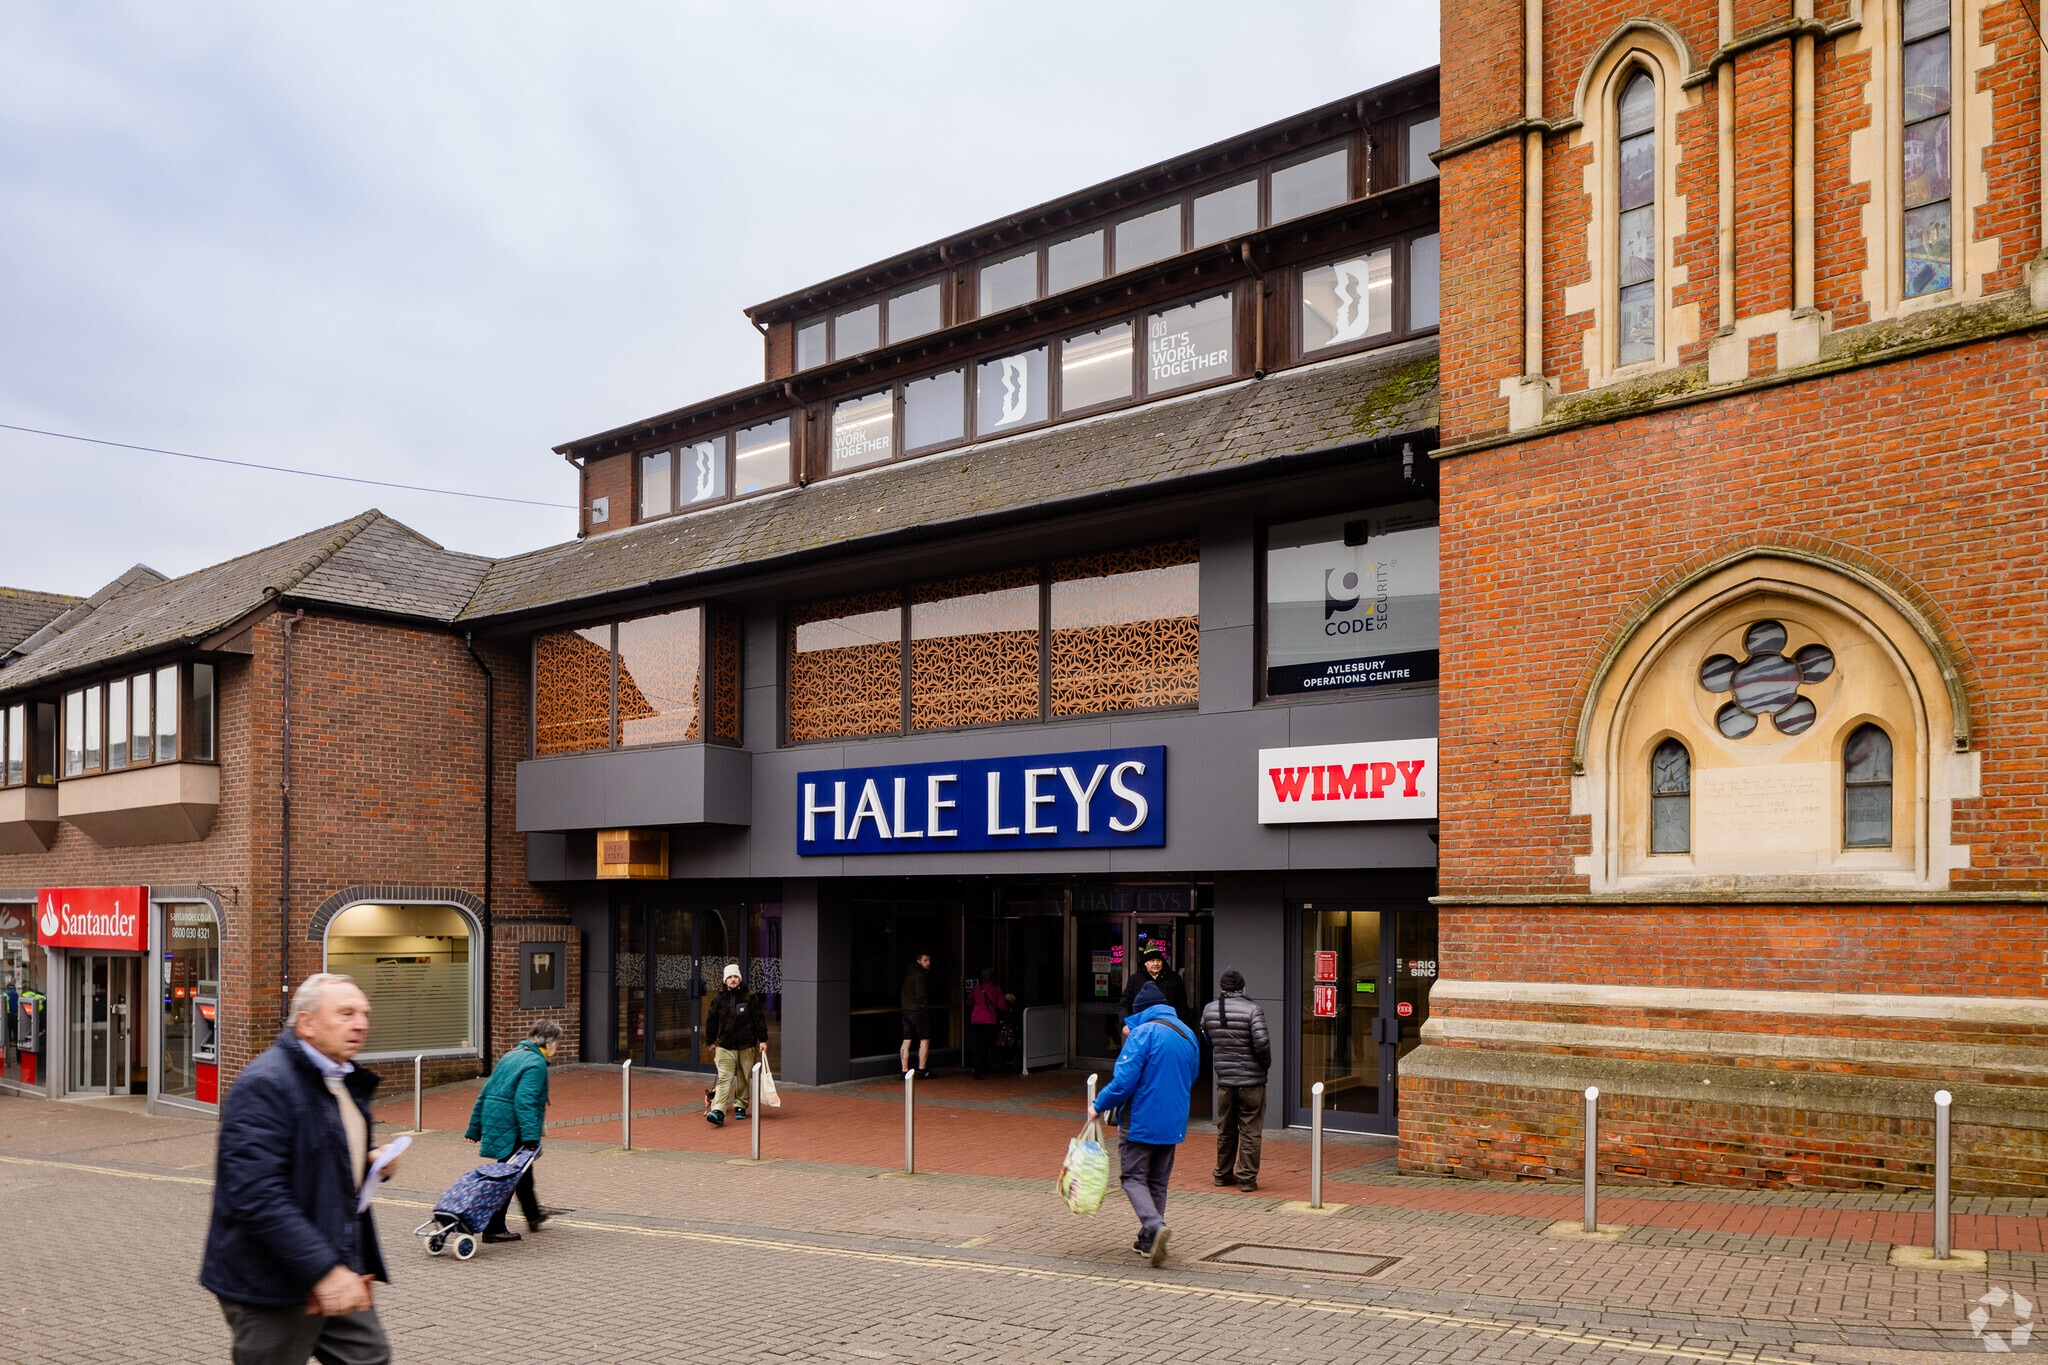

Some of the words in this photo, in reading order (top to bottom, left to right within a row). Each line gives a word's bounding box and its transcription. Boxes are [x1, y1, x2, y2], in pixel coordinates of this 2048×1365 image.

[1152, 332, 1190, 353] LET'S
[1152, 343, 1196, 366] WORK
[1152, 349, 1228, 380] TOGETHER
[835, 430, 866, 448] WORK
[835, 436, 890, 460] TOGETHER
[1376, 561, 1388, 630] SECURITY
[1325, 617, 1375, 636] CODE
[1327, 660, 1386, 674] AYLESBURY
[1303, 674, 1367, 687] OPERATIONS
[1369, 669, 1410, 681] CENTRE
[1268, 760, 1426, 803] WIMPY
[803, 774, 958, 841] HALE
[987, 760, 1150, 835] LEYS
[608, 852, 625, 860] YORK
[1080, 892, 1129, 911] HALE
[1137, 892, 1181, 911] LEYS
[61, 900, 136, 937] Santander
[170, 910, 212, 922] santander.co.uk
[172, 927, 185, 938] 0800
[186, 927, 196, 938] 030
[197, 927, 210, 939] 4321
